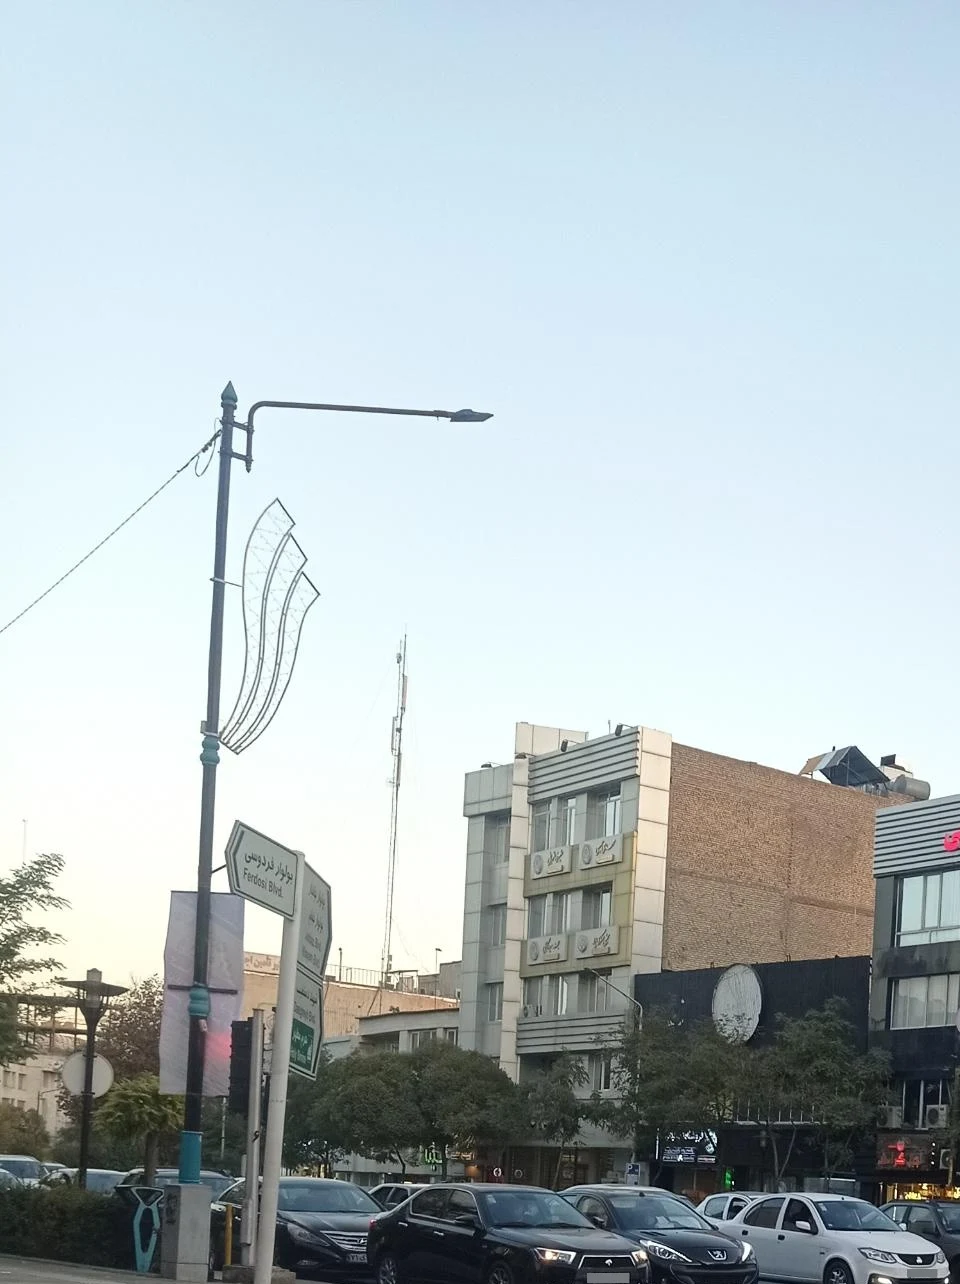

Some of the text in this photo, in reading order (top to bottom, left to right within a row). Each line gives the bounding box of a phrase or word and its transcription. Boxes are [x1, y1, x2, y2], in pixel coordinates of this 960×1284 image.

[243, 867, 267, 890] Ferdosi
[244, 852, 293, 885] بولوار فردوسی
